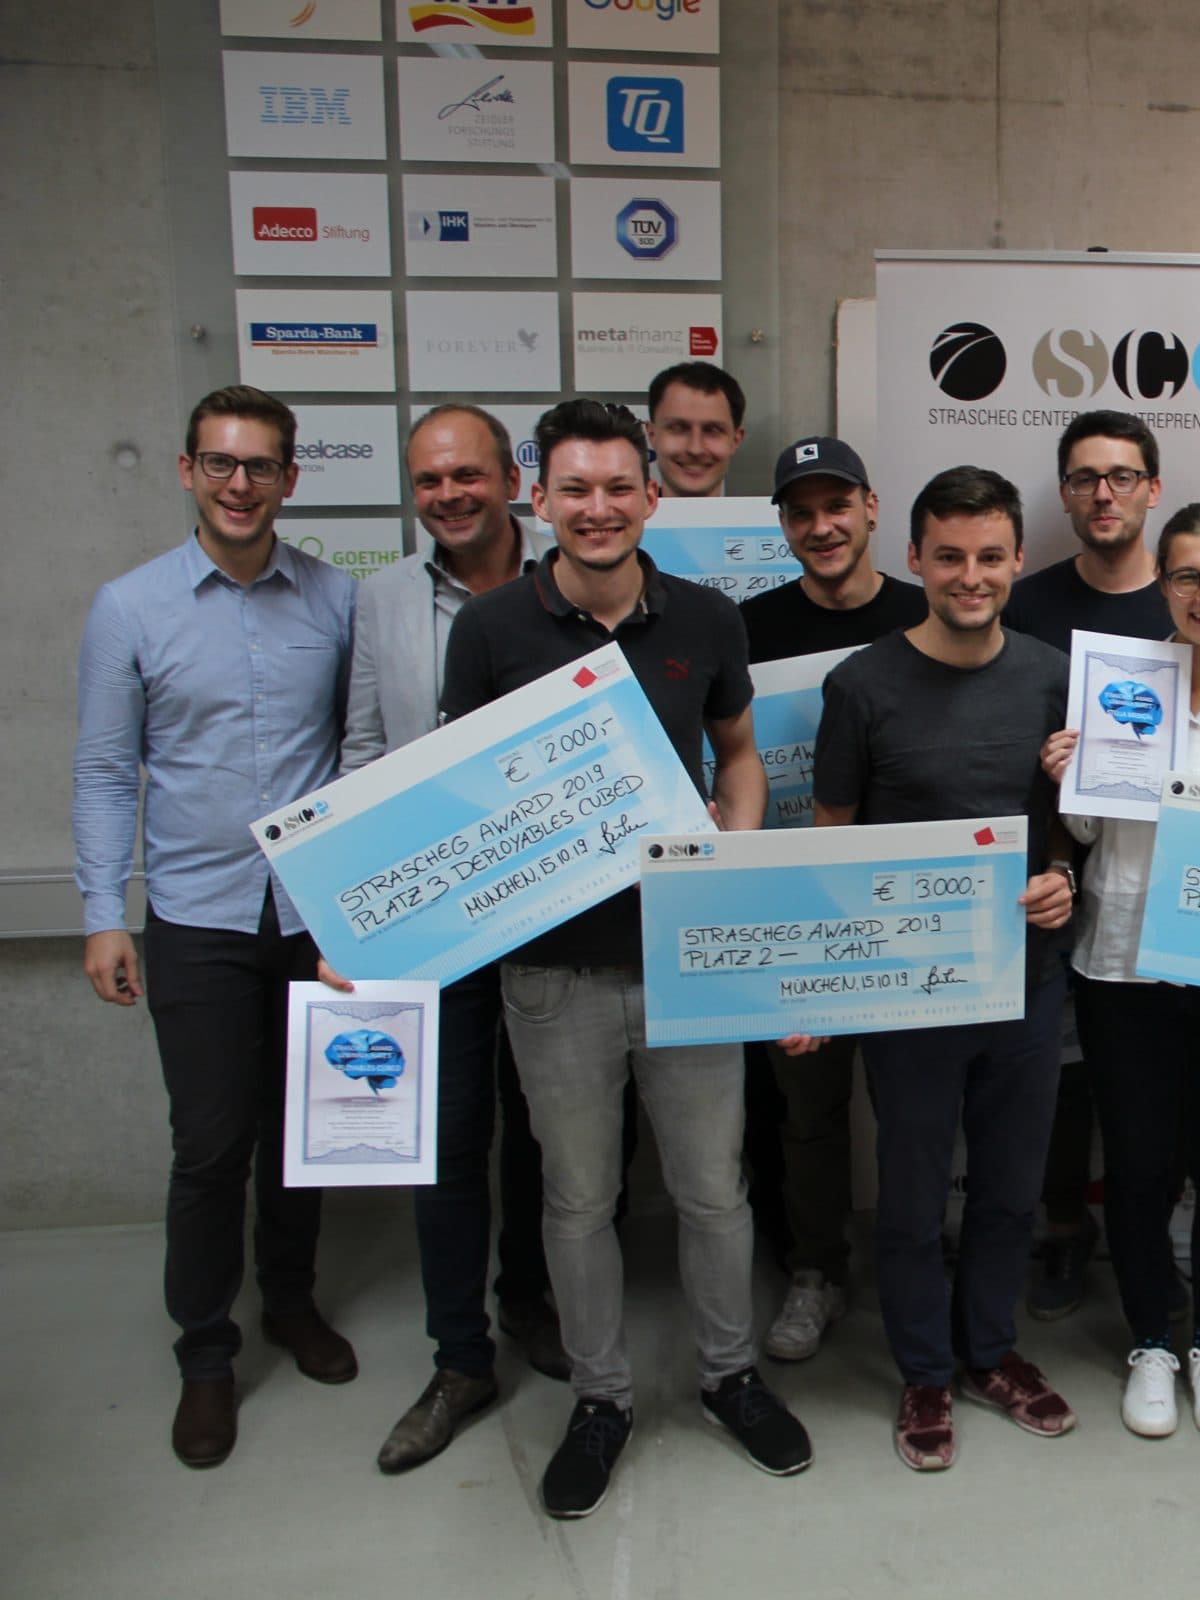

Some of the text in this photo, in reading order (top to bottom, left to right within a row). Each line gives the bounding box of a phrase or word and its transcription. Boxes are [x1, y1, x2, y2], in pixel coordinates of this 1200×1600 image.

[585, 0, 700, 20] ooge
[259, 86, 352, 125] IBM
[619, 89, 671, 143] TQ
[442, 216, 467, 228] IHK
[258, 223, 370, 242] Adecco Stiftung
[266, 326, 363, 341] Sparda-Bank
[577, 326, 683, 343] metafinanz
[426, 341, 518, 353] FOREVER
[928, 408, 1018, 426] STRASCHEG
[295, 440, 373, 459] eelcase
[340, 835, 469, 912] STRASCHEG
[480, 792, 553, 842] AWARD
[562, 764, 605, 800] 2019
[352, 889, 424, 932] PLATZ
[427, 878, 449, 904] 3
[450, 811, 573, 882] DEPLOYABLES
[578, 775, 644, 817] CUBED
[685, 914, 942, 946] STRASCHEG AWARD 2019
[684, 949, 754, 969] PLATZ
[759, 947, 774, 966] 2
[824, 940, 888, 962] KANT
